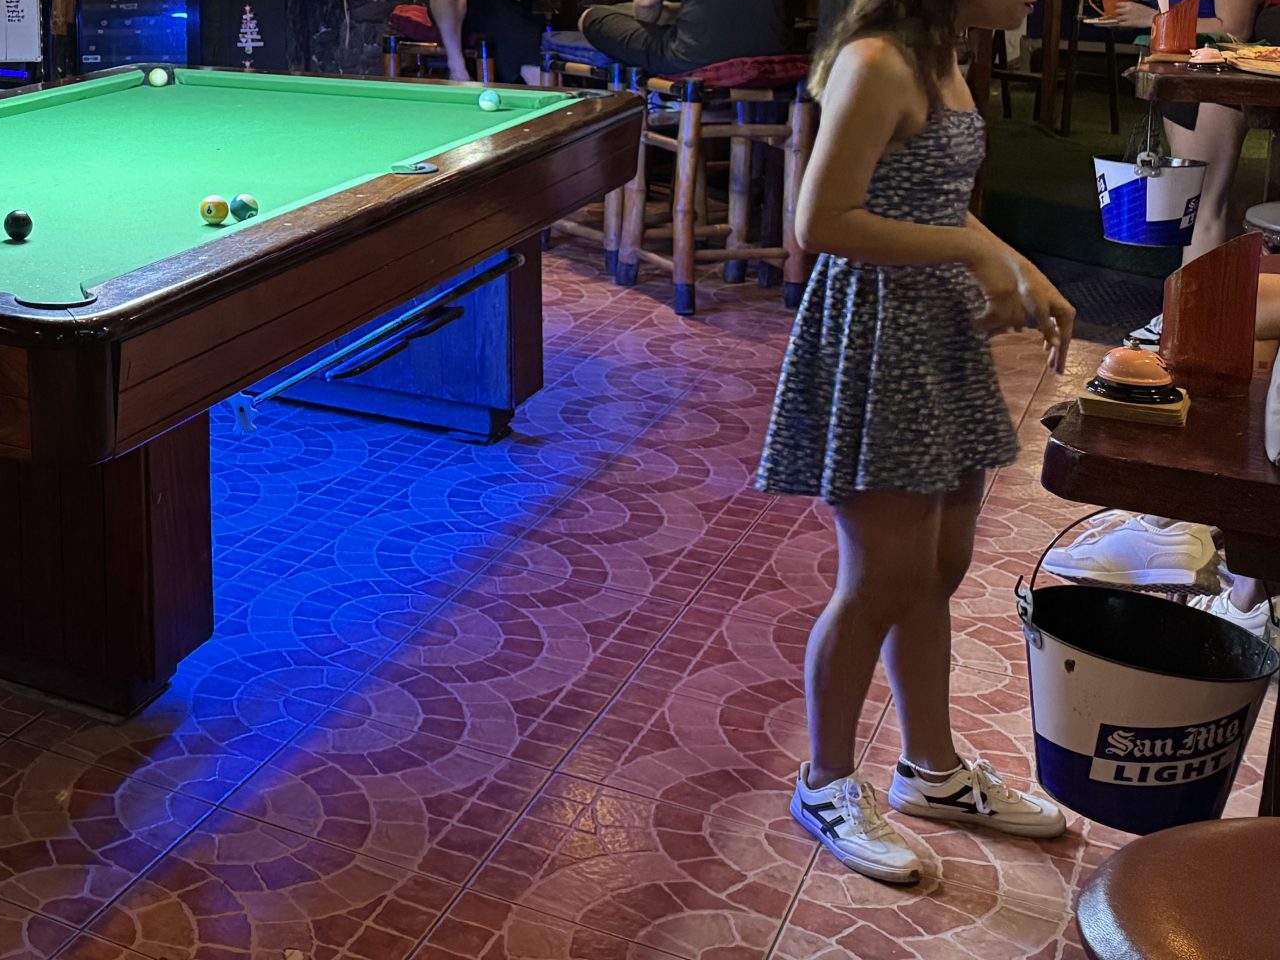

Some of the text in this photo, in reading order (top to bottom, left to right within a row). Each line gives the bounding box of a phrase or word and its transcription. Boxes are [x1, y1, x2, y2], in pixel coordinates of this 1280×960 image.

[206, 205, 213, 215] 6
[1105, 718, 1240, 759] San Mig
[1113, 750, 1229, 783] LIGHT
